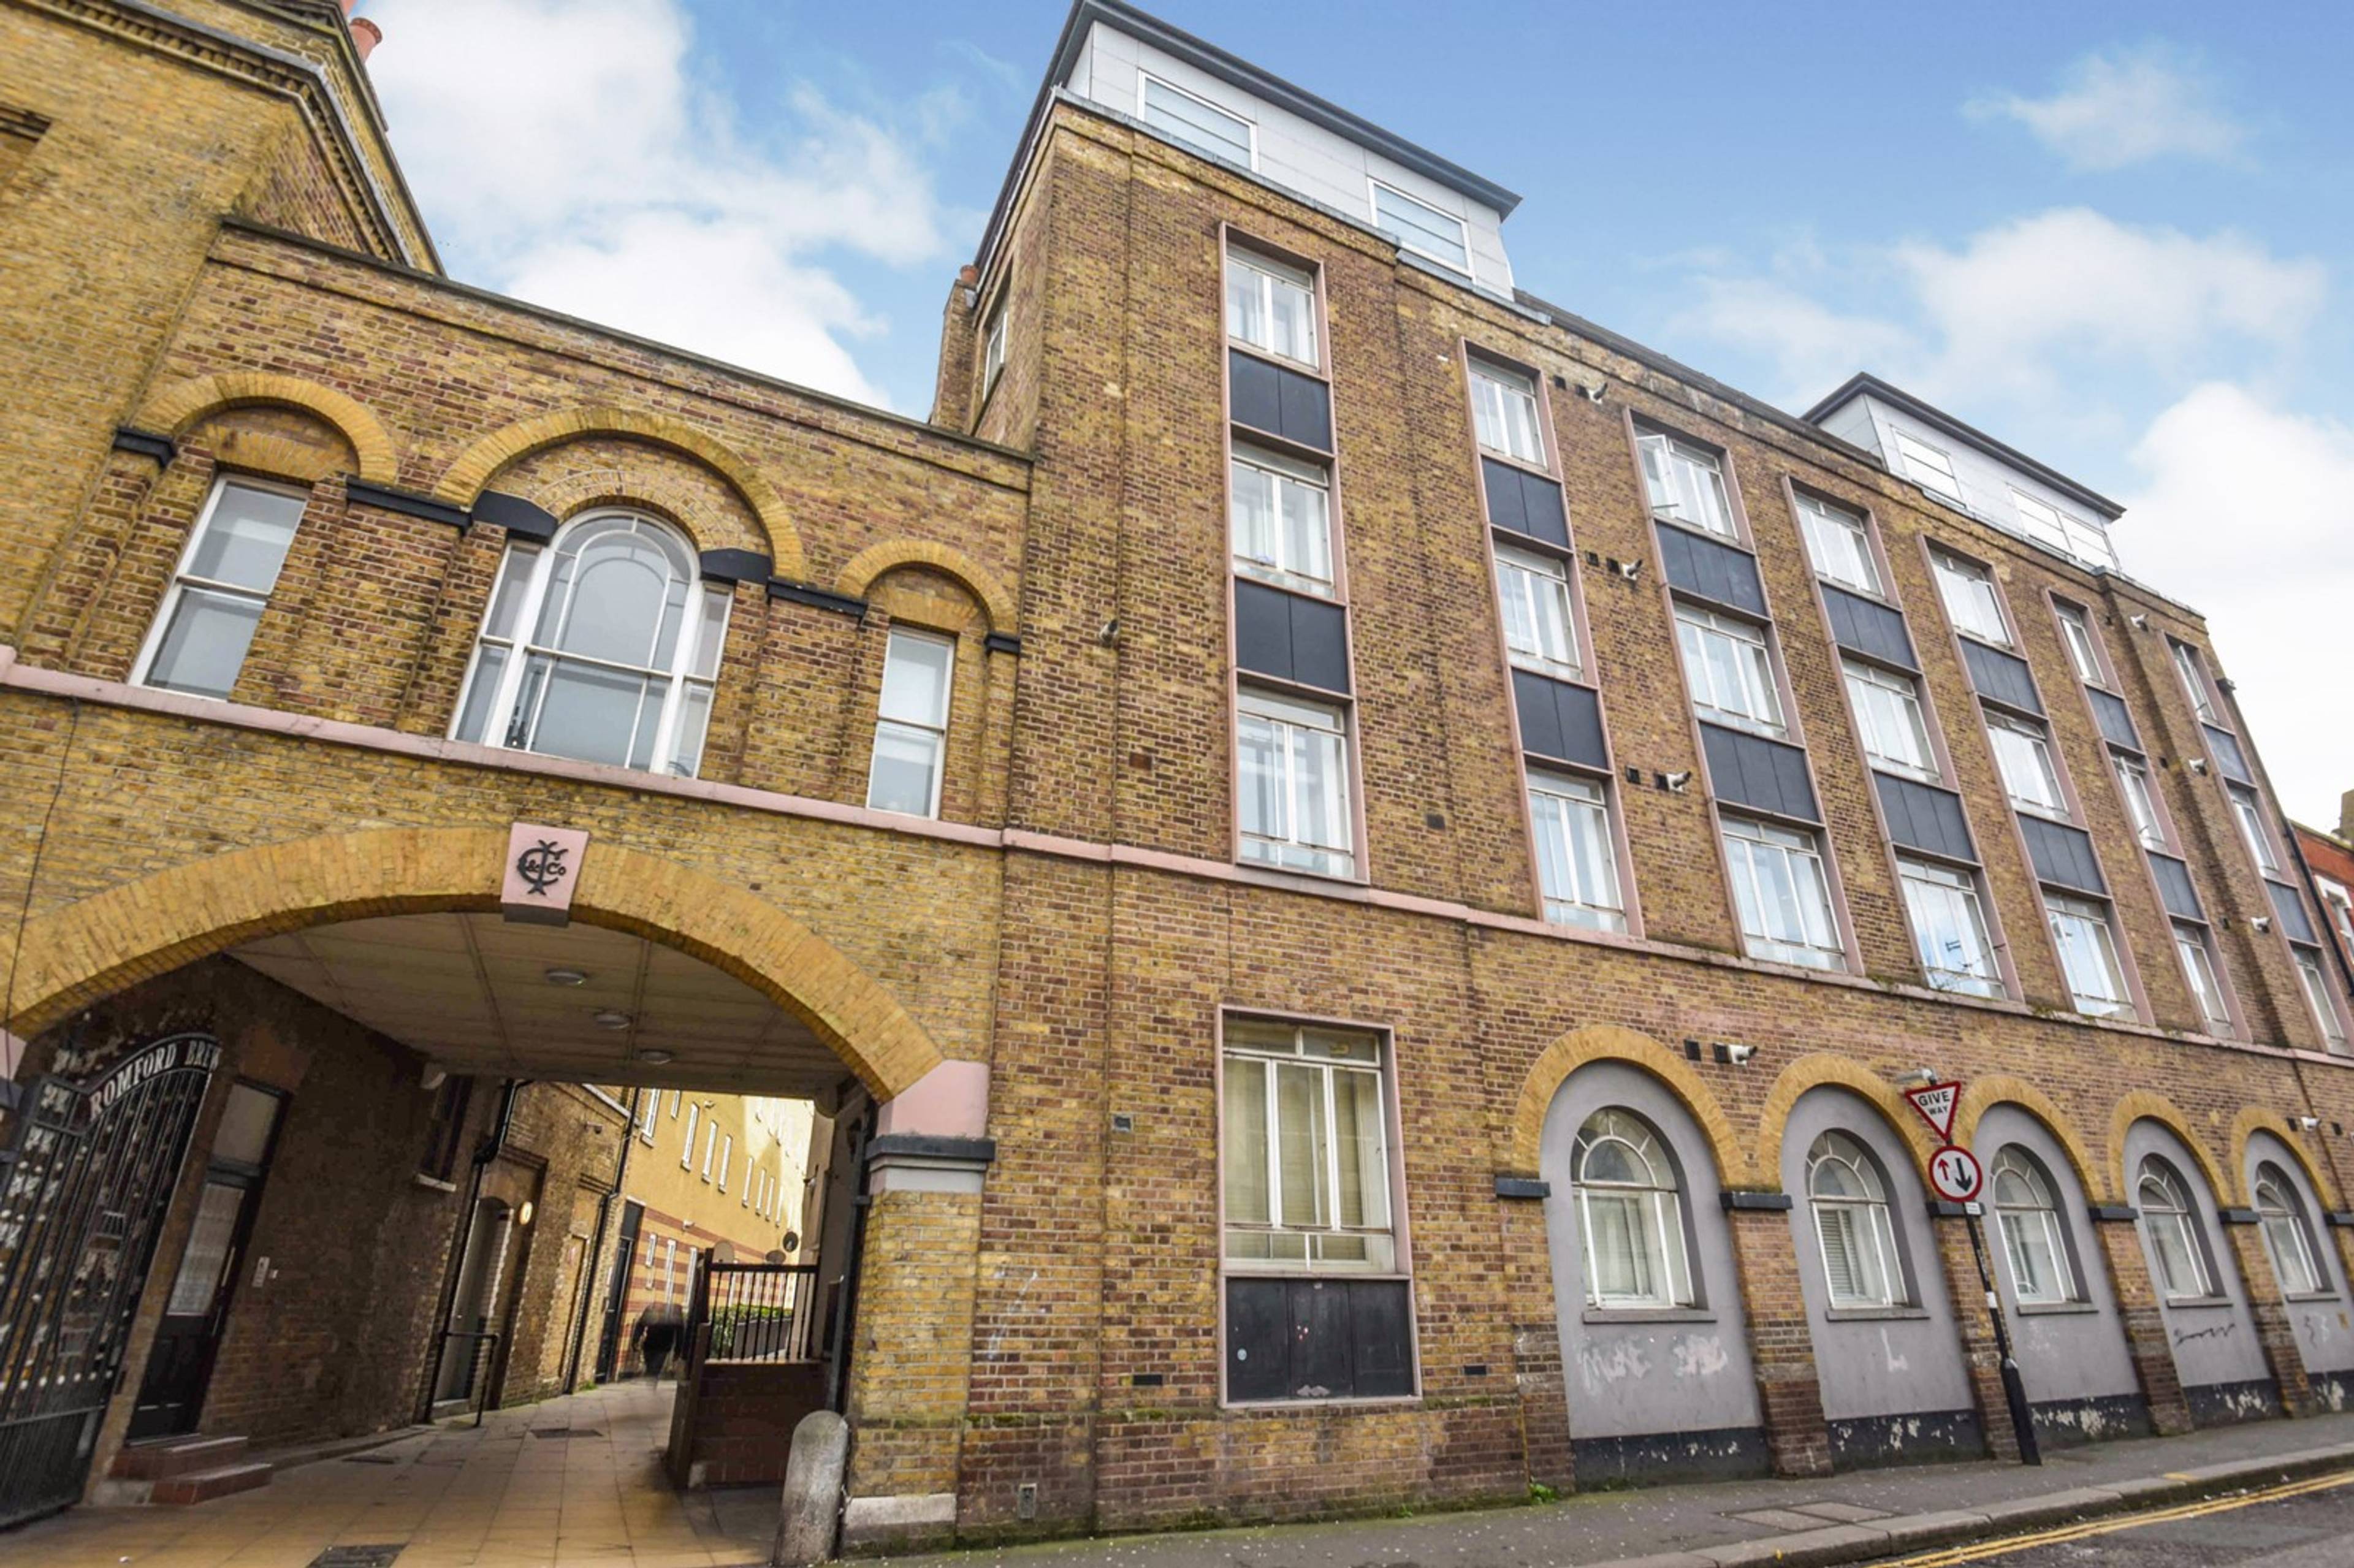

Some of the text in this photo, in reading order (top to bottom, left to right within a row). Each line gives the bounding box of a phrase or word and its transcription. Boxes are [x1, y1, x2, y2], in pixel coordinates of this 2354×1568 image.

[90, 1043, 177, 1121] ROMFORD
[1919, 1091, 1950, 1106] GIVE
[1929, 1106, 1948, 1115] WAY
